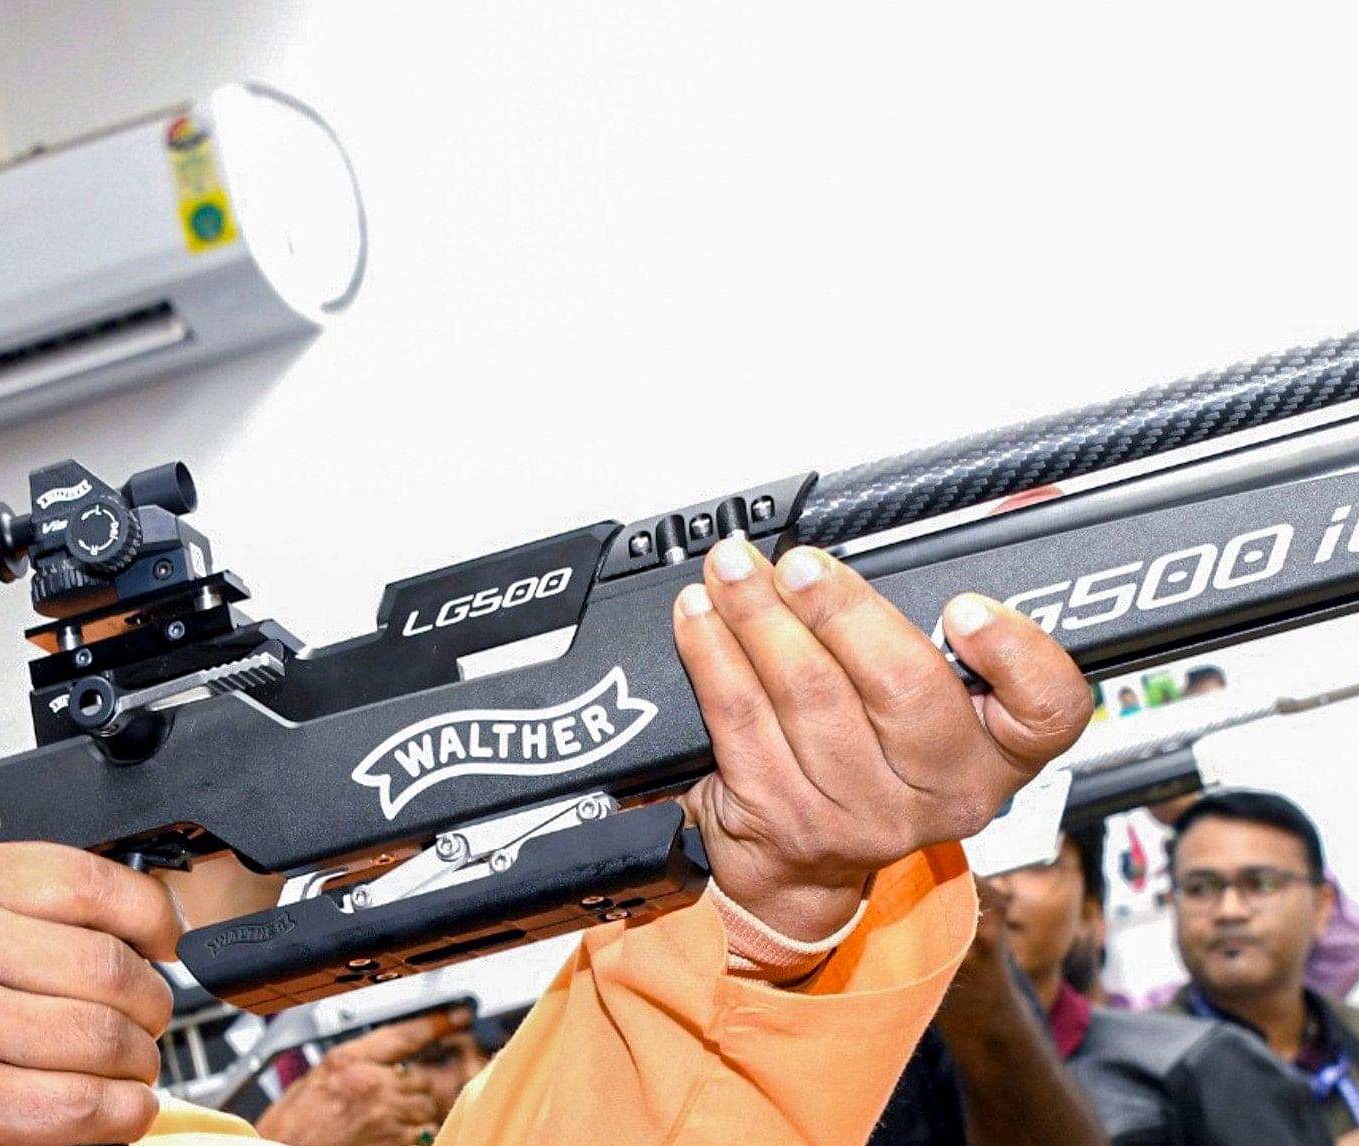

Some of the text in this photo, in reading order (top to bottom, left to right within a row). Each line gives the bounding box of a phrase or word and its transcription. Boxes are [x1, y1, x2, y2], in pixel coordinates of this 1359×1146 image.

[402, 566, 573, 637] LG500
[930, 523, 1294, 640] G500
[393, 704, 616, 778] WALTHER
